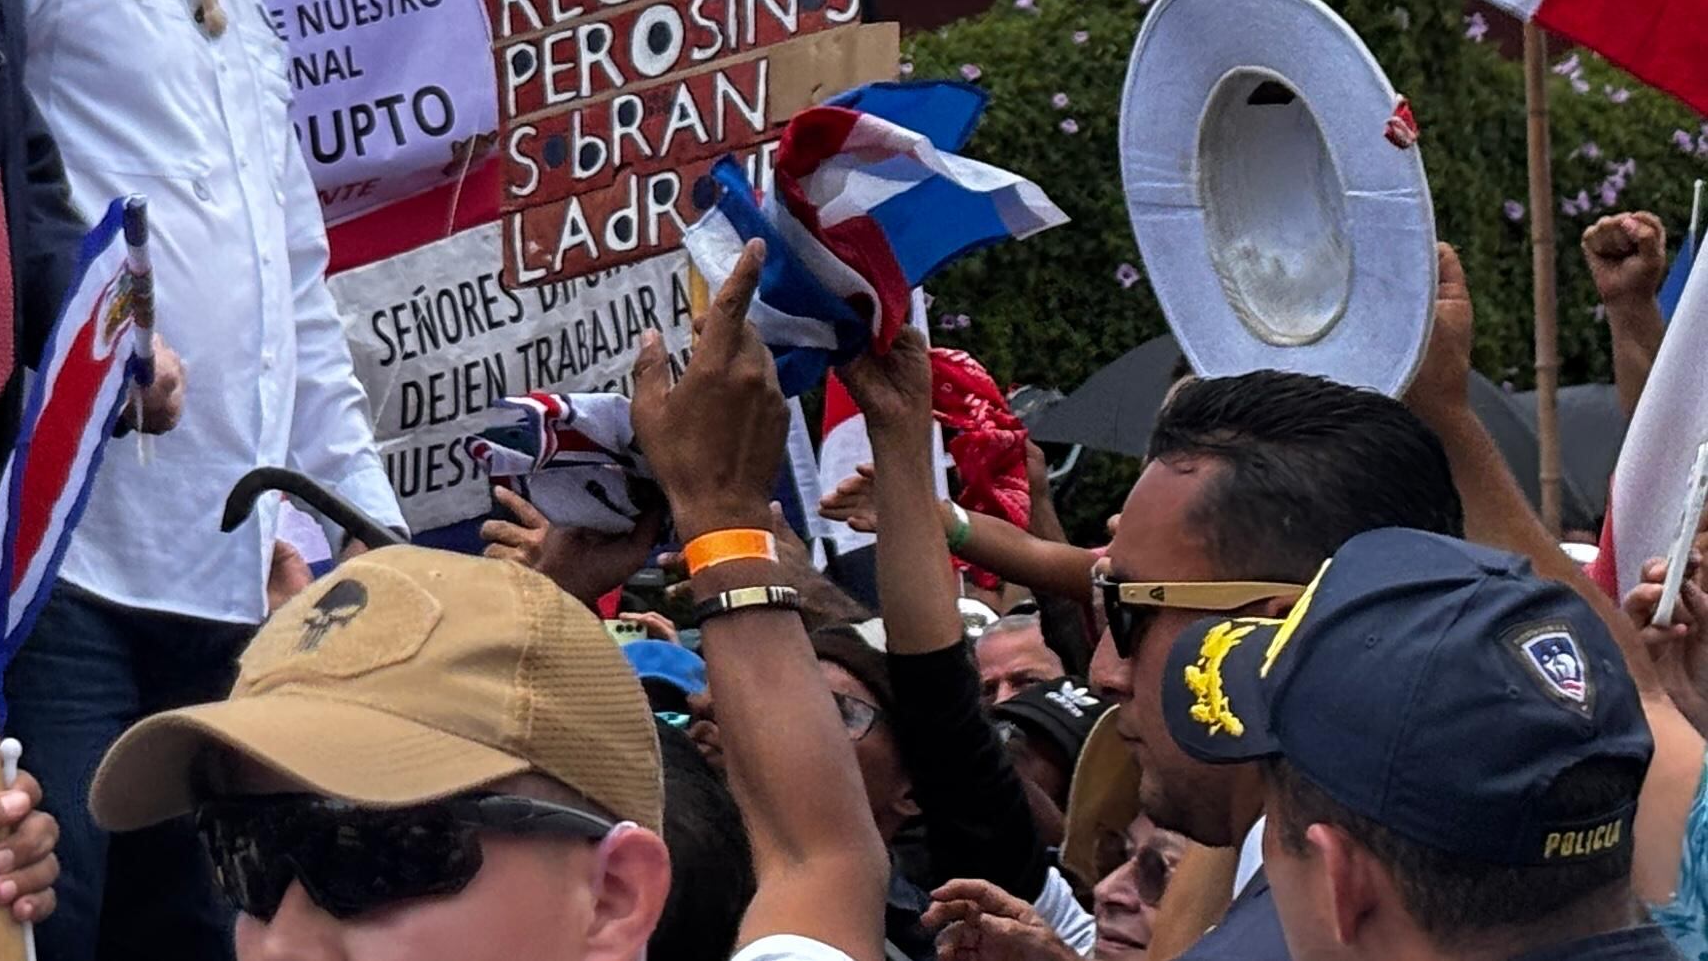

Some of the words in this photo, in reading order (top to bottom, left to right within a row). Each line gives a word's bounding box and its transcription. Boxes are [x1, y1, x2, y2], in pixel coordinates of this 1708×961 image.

[287, 45, 364, 90] NAL
[294, 84, 456, 164] UPTO
[372, 269, 525, 367] SEÑORES
[400, 352, 507, 430] DEJEN
[516, 285, 664, 394] TRABAJAR
